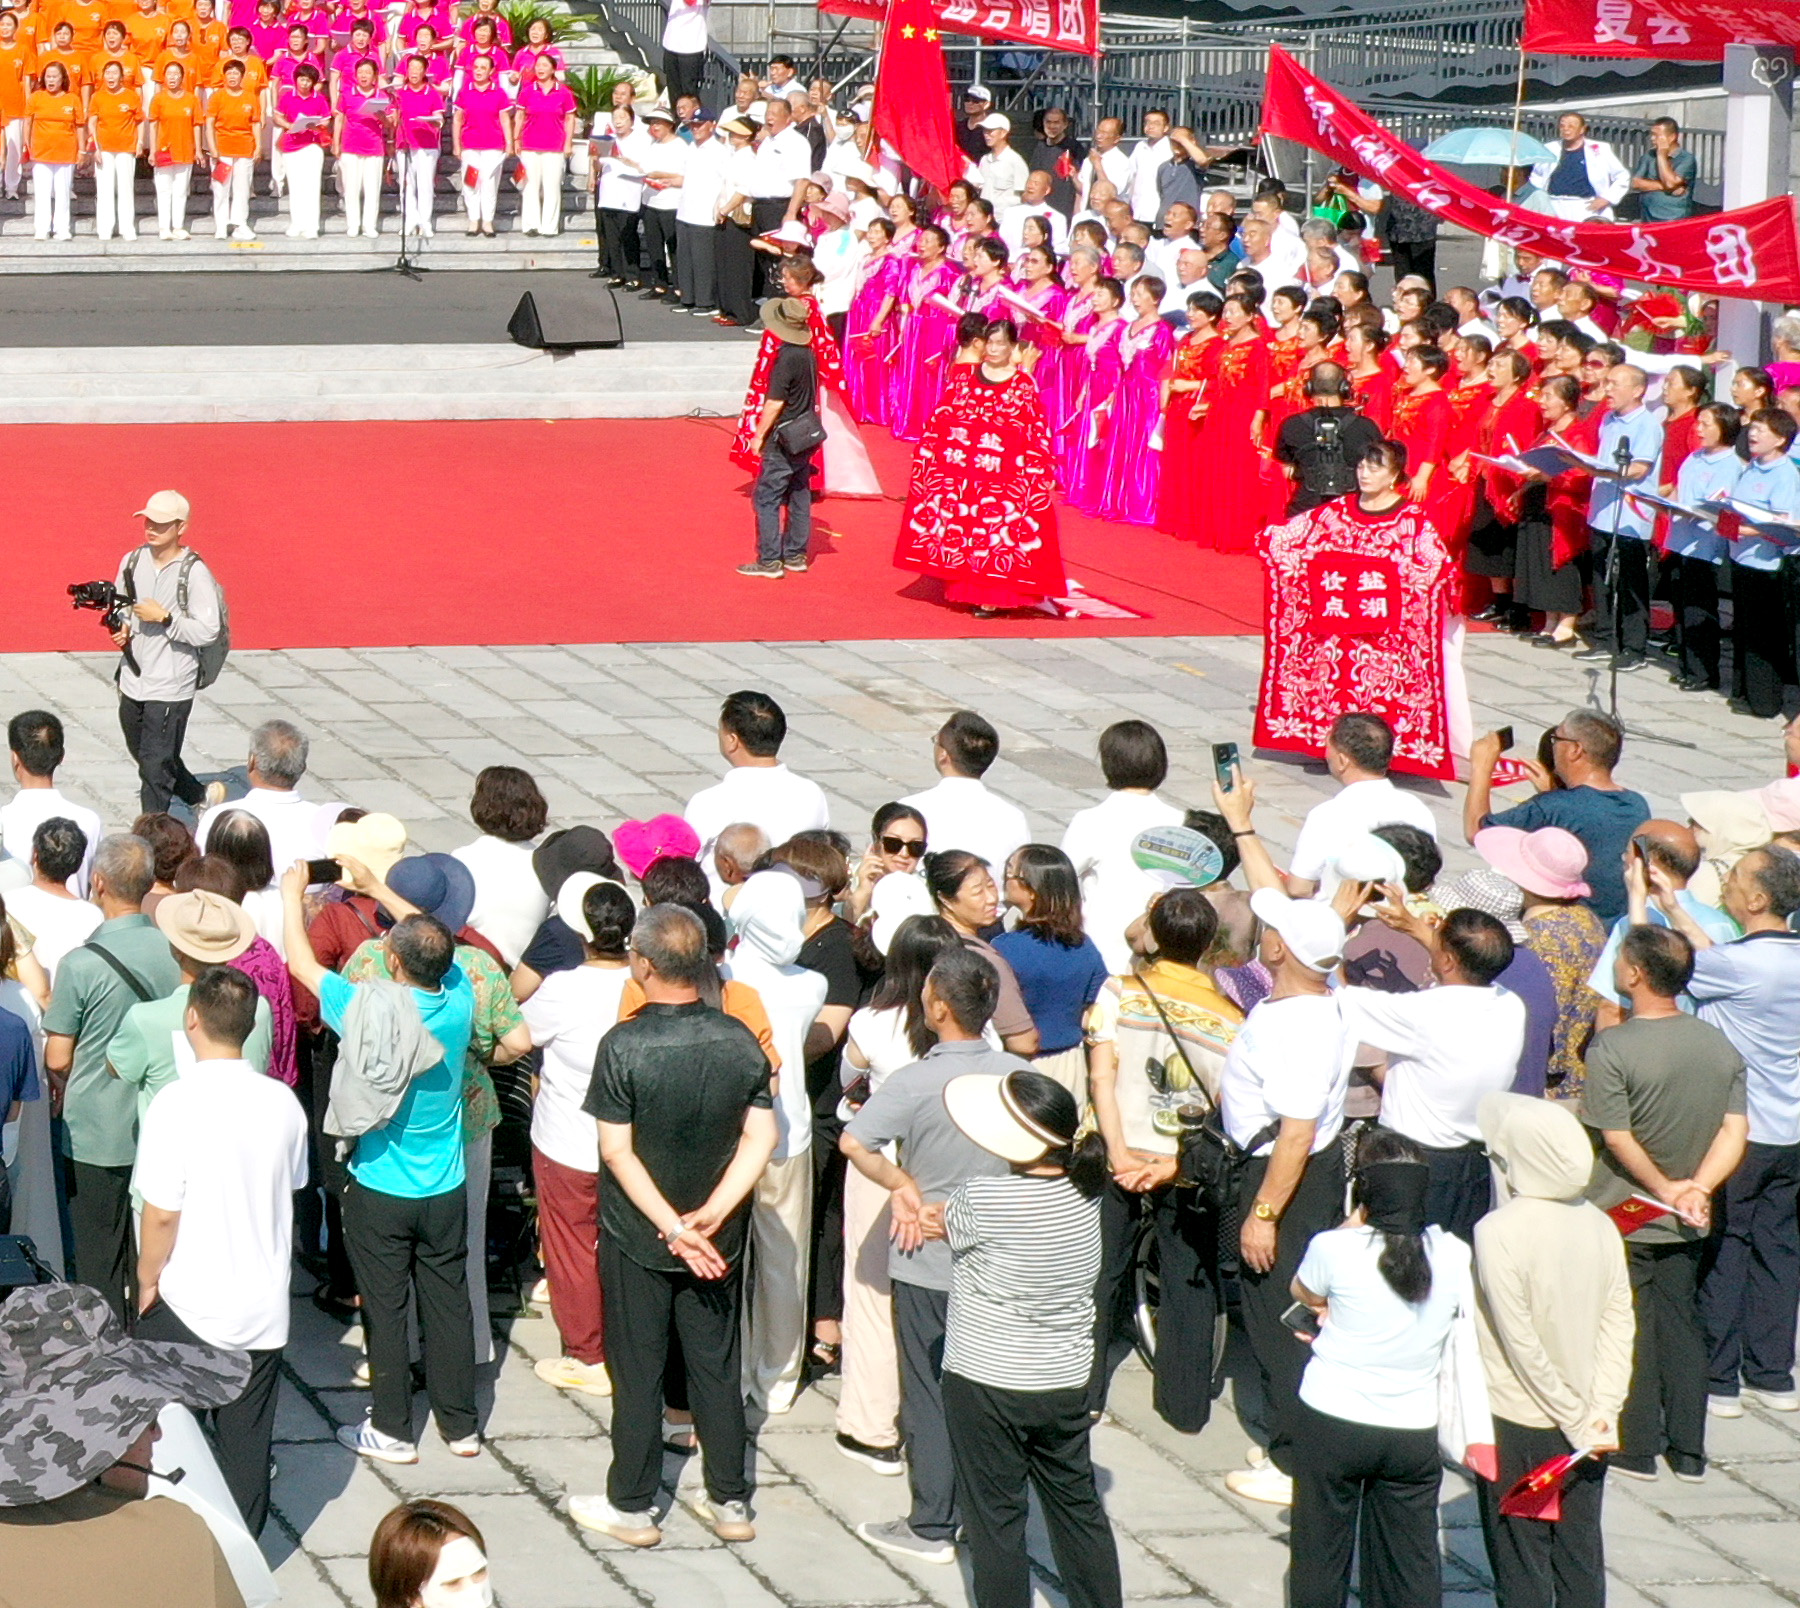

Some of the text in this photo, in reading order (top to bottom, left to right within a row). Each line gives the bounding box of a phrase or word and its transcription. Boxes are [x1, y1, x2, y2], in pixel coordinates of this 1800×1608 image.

[974, 432, 1005, 473] 盐湖
[1320, 570, 1351, 619] 妆点
[1357, 570, 1388, 619] 盐湖
